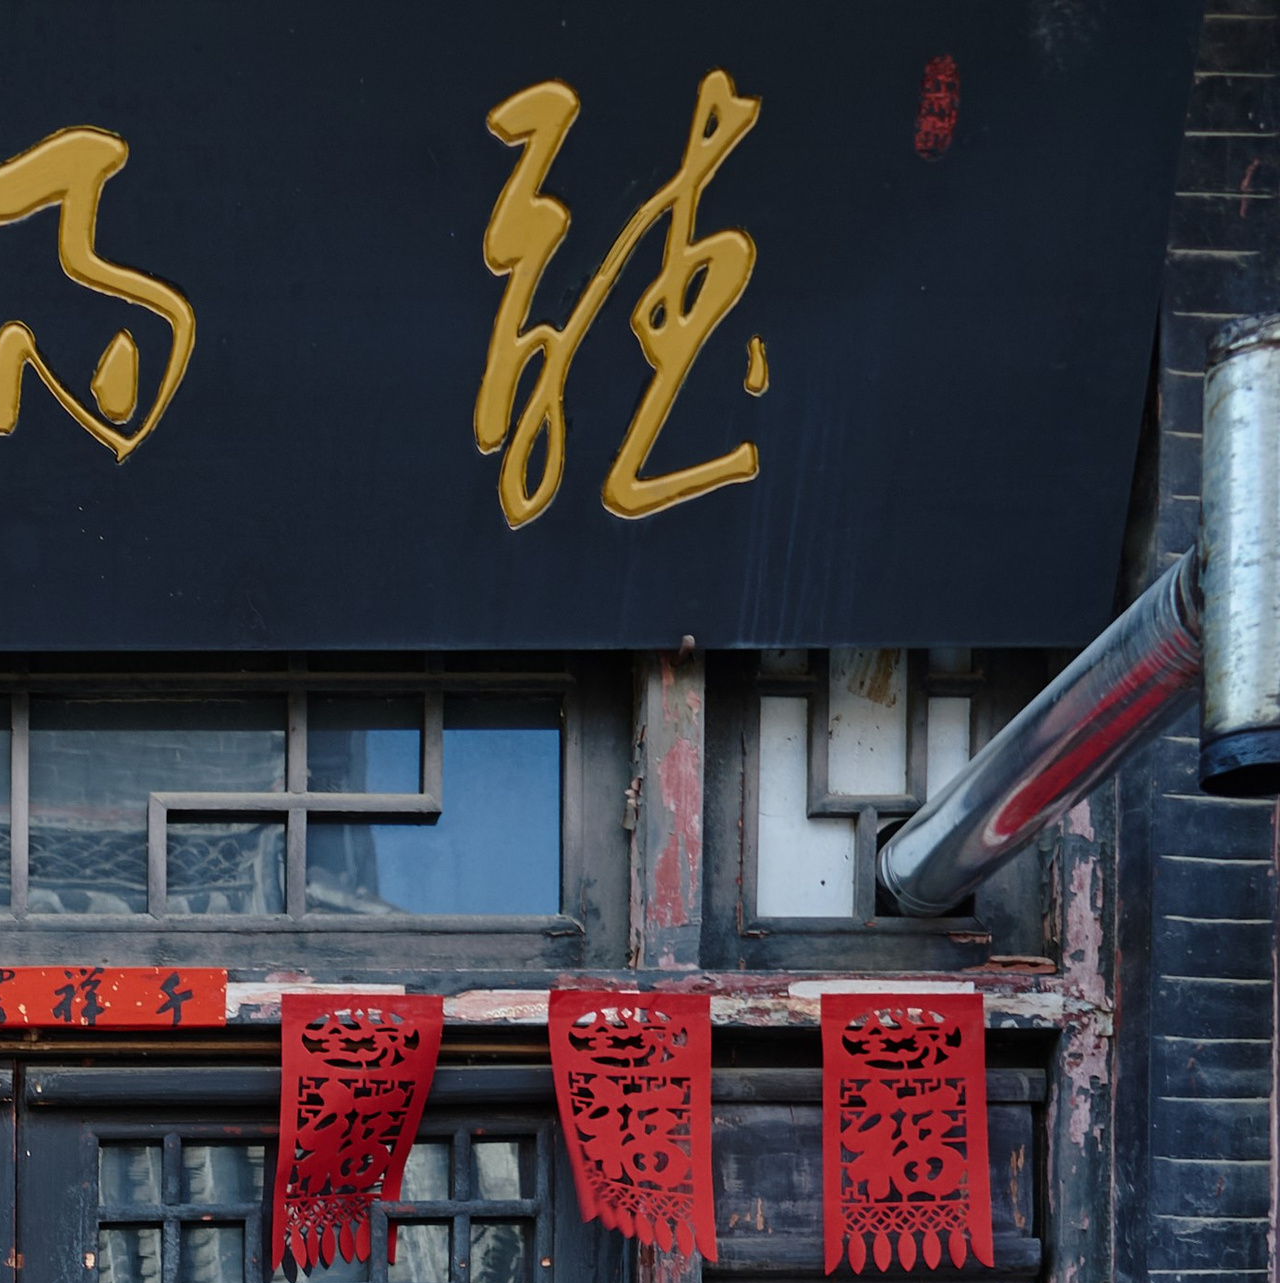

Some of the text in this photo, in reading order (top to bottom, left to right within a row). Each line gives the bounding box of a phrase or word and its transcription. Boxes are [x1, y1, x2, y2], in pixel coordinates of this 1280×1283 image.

[296, 1079, 406, 1195] 福
[575, 1076, 692, 1191] 福
[841, 1079, 968, 1201] 福
